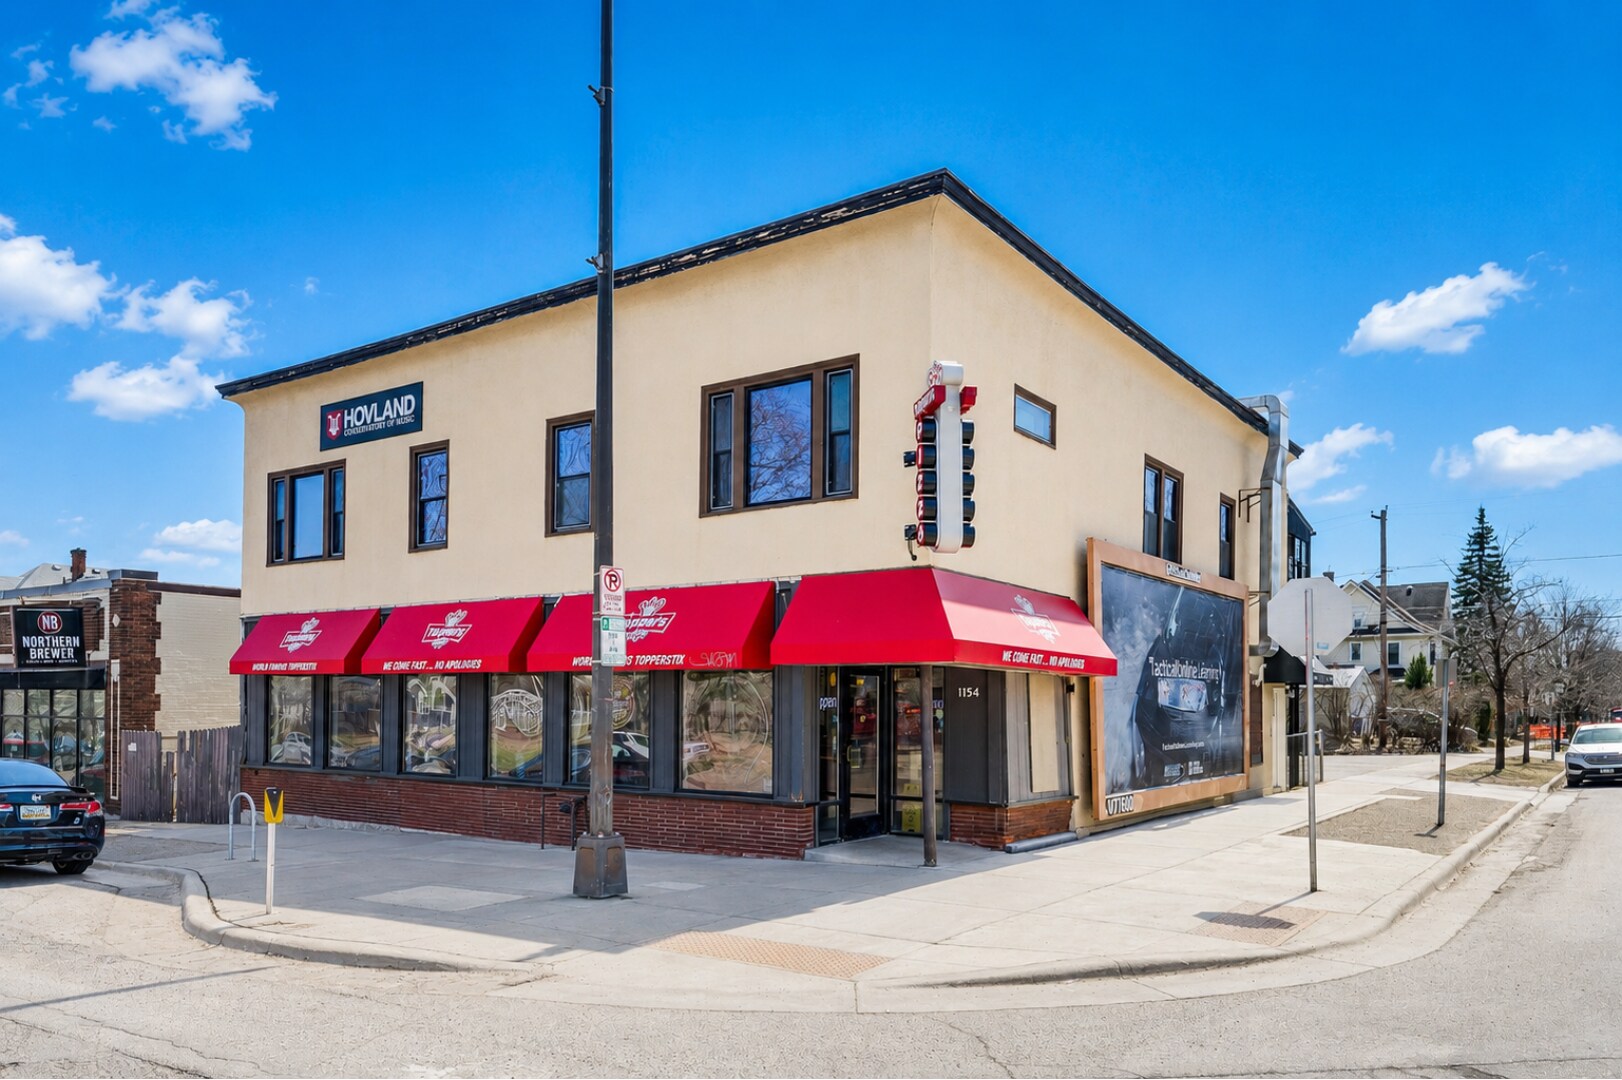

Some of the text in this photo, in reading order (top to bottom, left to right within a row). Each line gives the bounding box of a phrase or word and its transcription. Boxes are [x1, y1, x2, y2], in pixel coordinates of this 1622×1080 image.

[343, 394, 416, 429] HOVLAND
[41, 614, 58, 630] NB
[22, 635, 80, 648] NORTHERN
[29, 647, 75, 660] BREWER
[383, 661, 393, 671] WE
[392, 660, 412, 671] COME
[434, 660, 445, 670] NO
[444, 659, 482, 670] APOLOGIES
[634, 654, 686, 667] TOPPERSTIX
[957, 687, 980, 698] 1154
